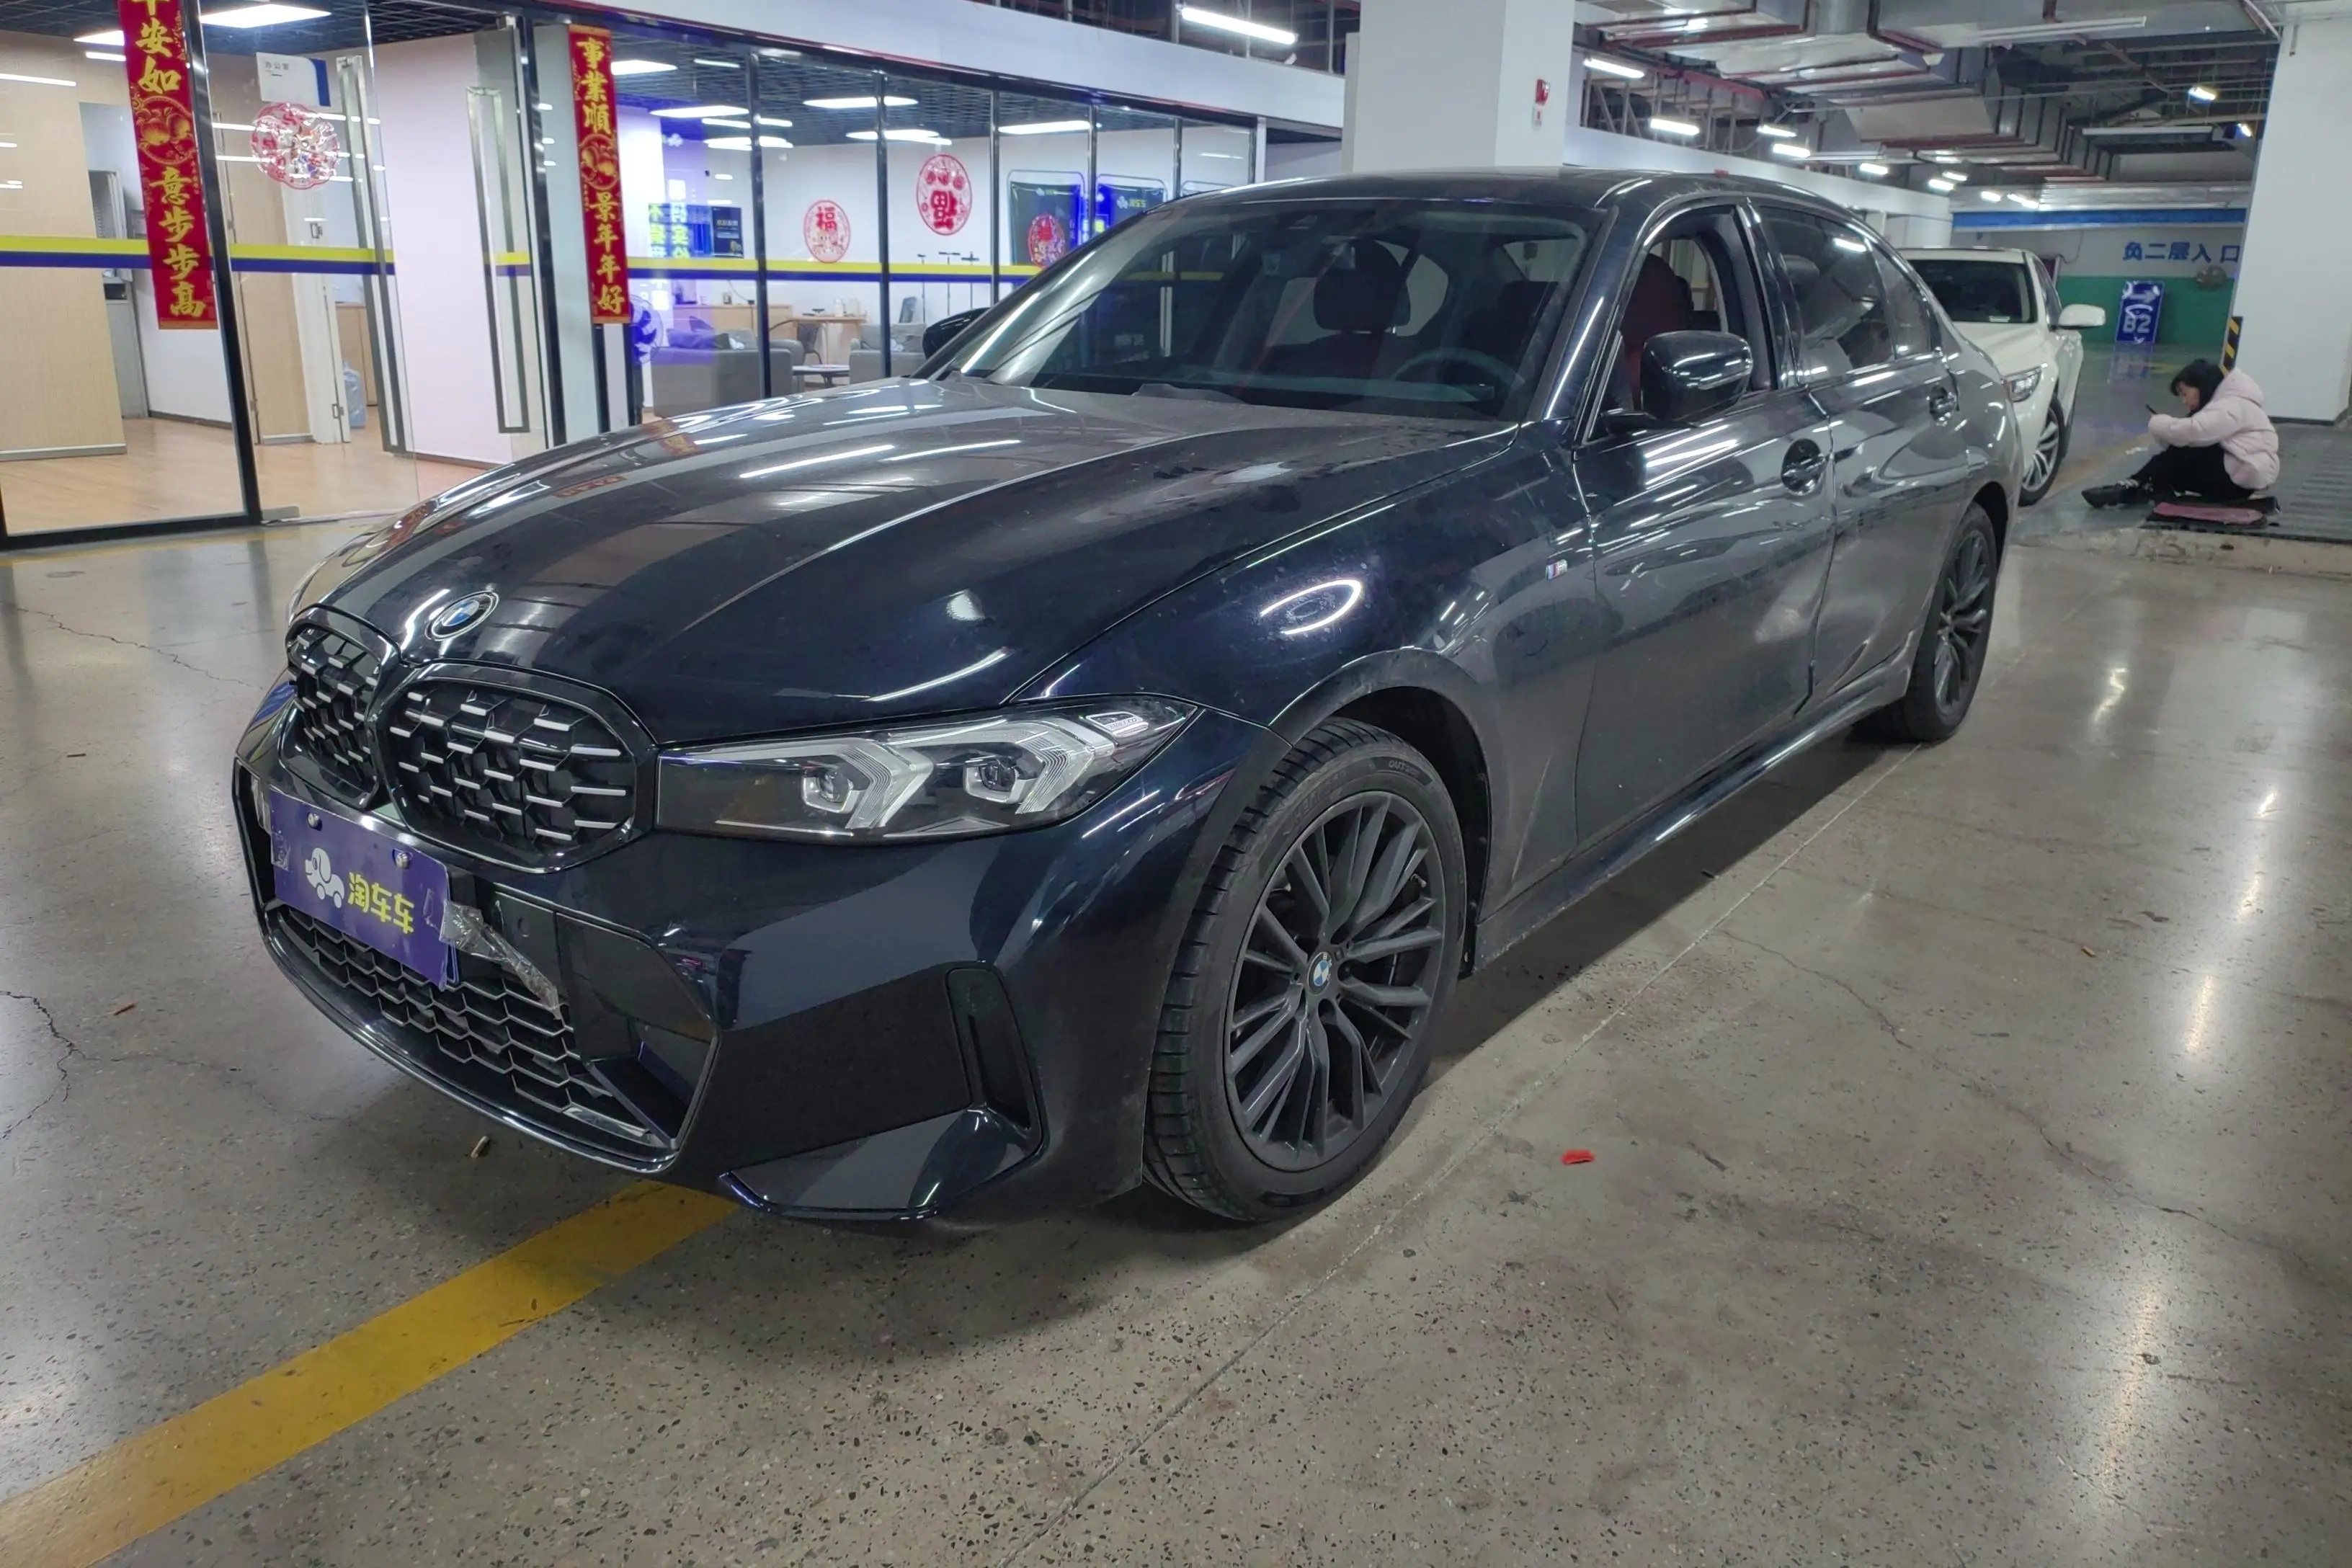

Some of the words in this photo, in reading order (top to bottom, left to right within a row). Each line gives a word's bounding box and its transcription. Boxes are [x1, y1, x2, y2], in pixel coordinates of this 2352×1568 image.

[815, 206, 837, 231] 福
[2122, 241, 2241, 264] 负二层入口
[2122, 313, 2152, 334] B2
[347, 871, 415, 935] 淘车车
